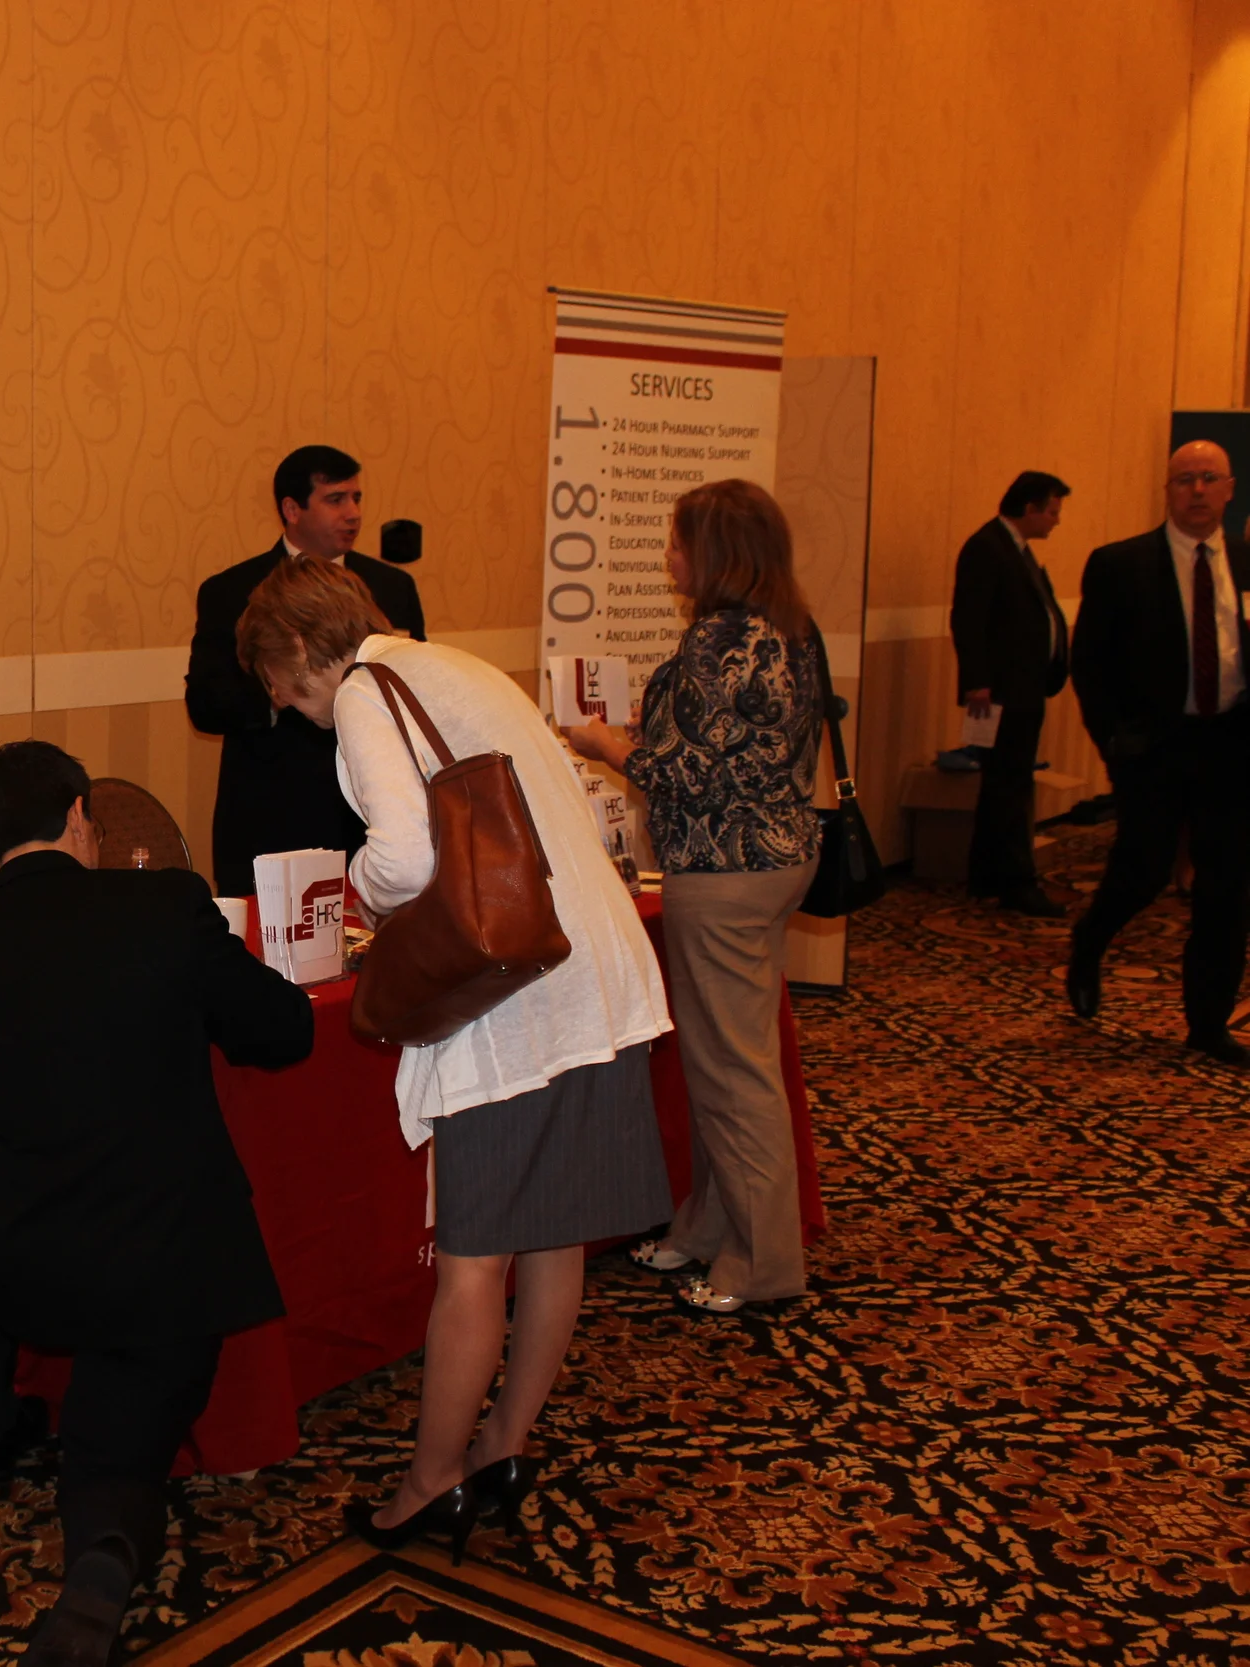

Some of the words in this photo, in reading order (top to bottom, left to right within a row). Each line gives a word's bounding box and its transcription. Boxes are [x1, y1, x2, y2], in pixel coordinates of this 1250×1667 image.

[630, 372, 714, 401] SERVICES
[612, 417, 627, 433] 24
[629, 419, 659, 434] HOUR
[661, 420, 716, 437] PHARMACY
[612, 441, 627, 456] 24
[628, 443, 659, 458] HOUR
[610, 488, 650, 503] PATIENT
[609, 535, 665, 550] EDUCATION
[607, 582, 633, 596] PLAN
[606, 605, 677, 620] PROFESSIONAL
[604, 797, 625, 816] HPC
[316, 901, 342, 926] HPC
